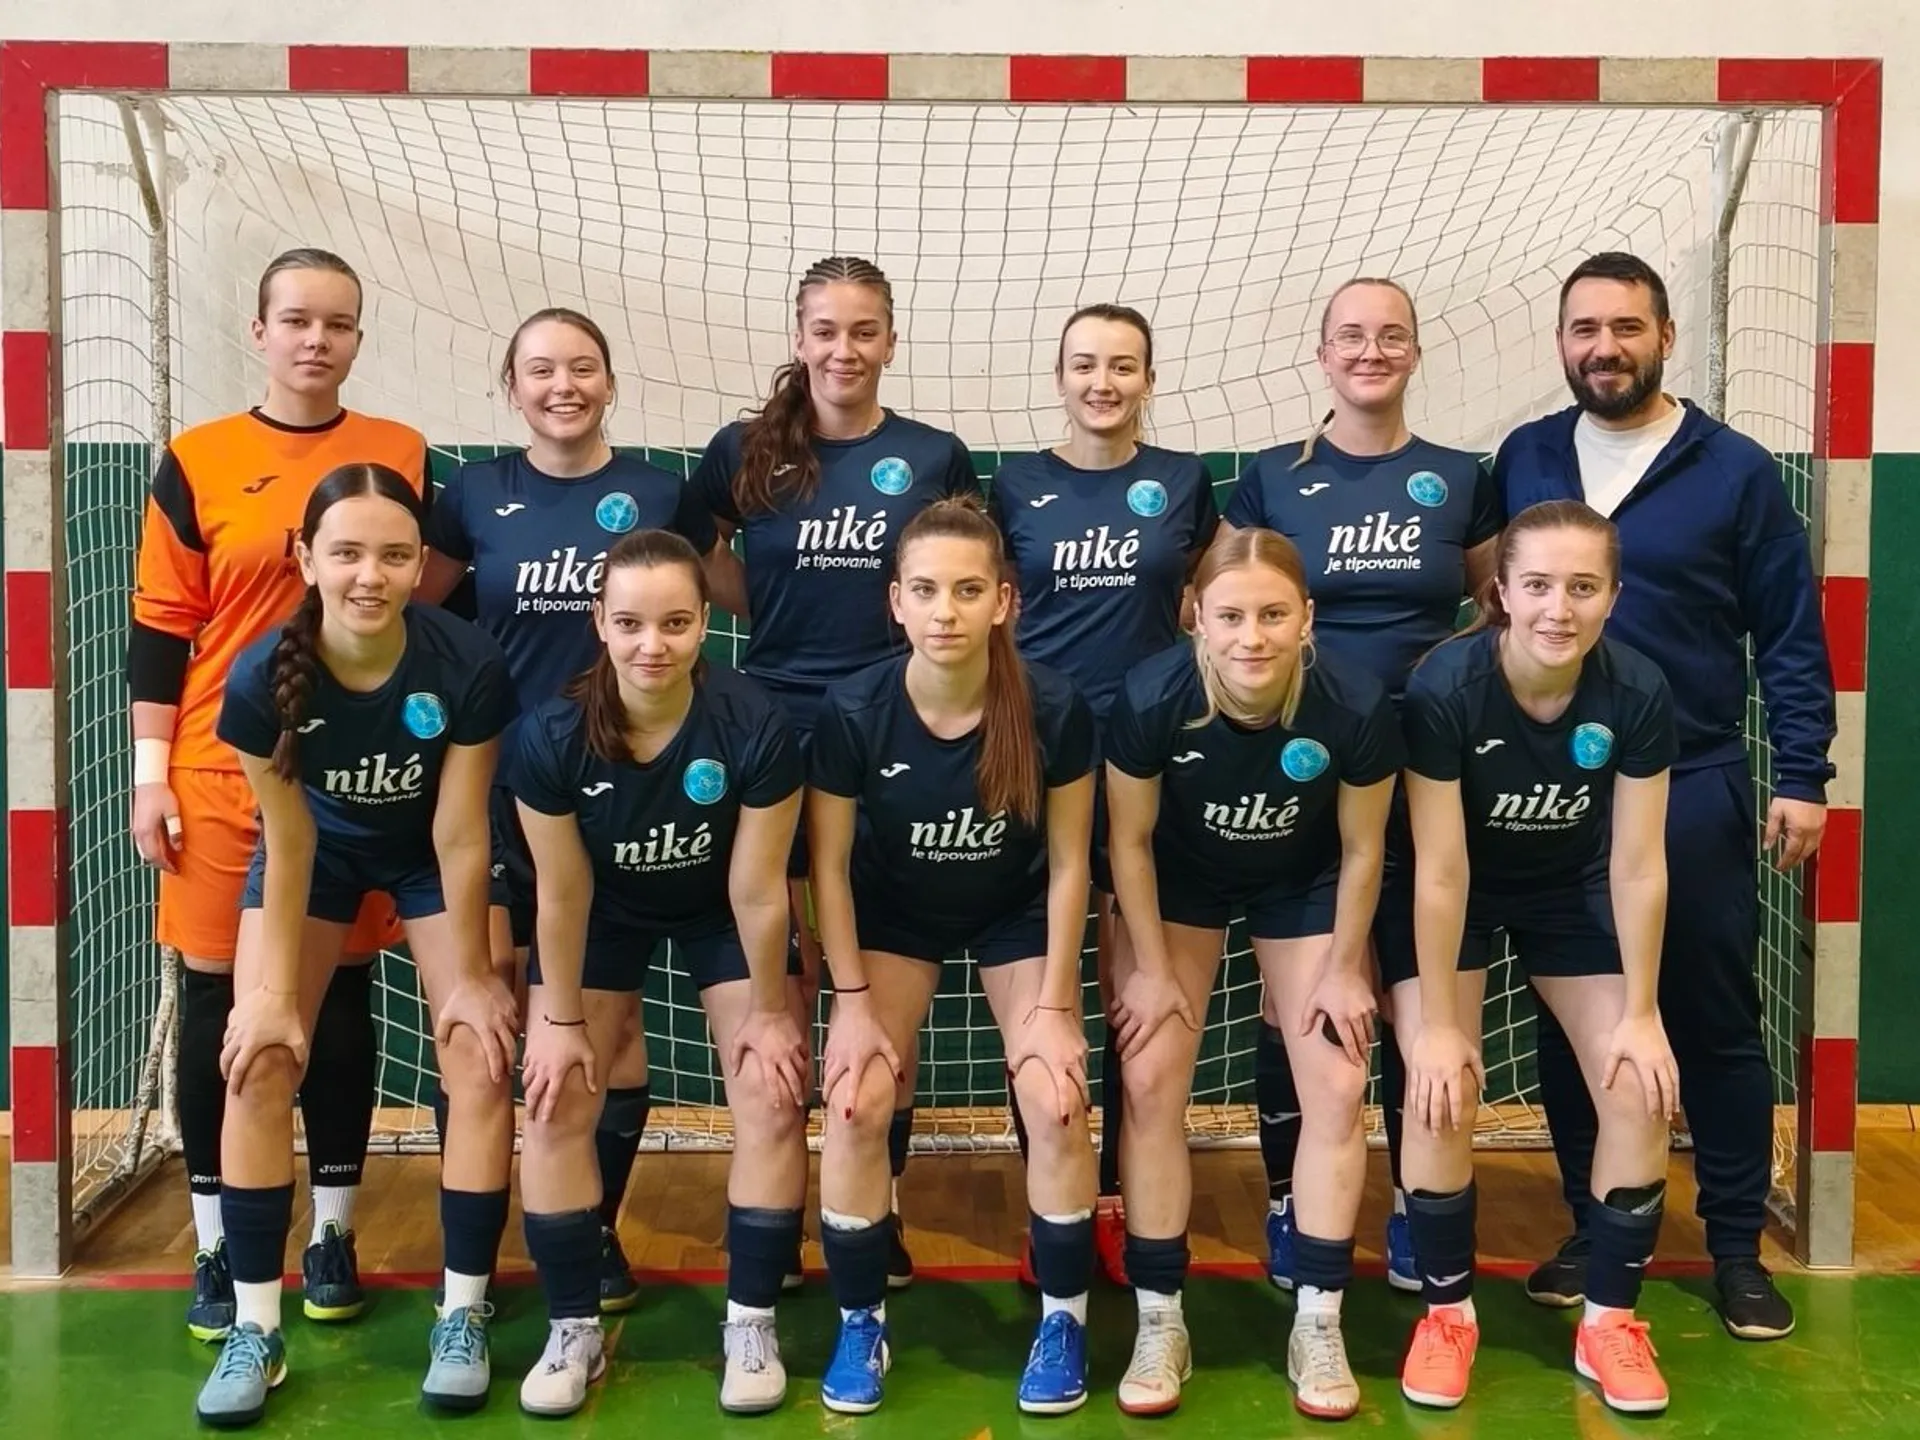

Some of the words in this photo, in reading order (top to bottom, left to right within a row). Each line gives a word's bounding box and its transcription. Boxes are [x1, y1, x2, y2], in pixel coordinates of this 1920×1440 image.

[797, 505, 888, 552] niké
[1052, 525, 1140, 571] niké
[1327, 511, 1422, 554] niké
[516, 546, 608, 594] niké
[795, 553, 811, 571] je
[813, 553, 882, 571] tipovanie
[1053, 575, 1068, 592] je
[1070, 572, 1137, 591] tipovanie
[1323, 557, 1343, 575] je
[1345, 555, 1421, 574] tipovanie
[515, 597, 531, 615] je
[532, 597, 597, 614] tipovani
[323, 752, 423, 794] niké
[1203, 792, 1300, 830] niké
[1489, 783, 1591, 820] niké
[613, 822, 712, 865] niké
[909, 807, 1007, 848] niké
